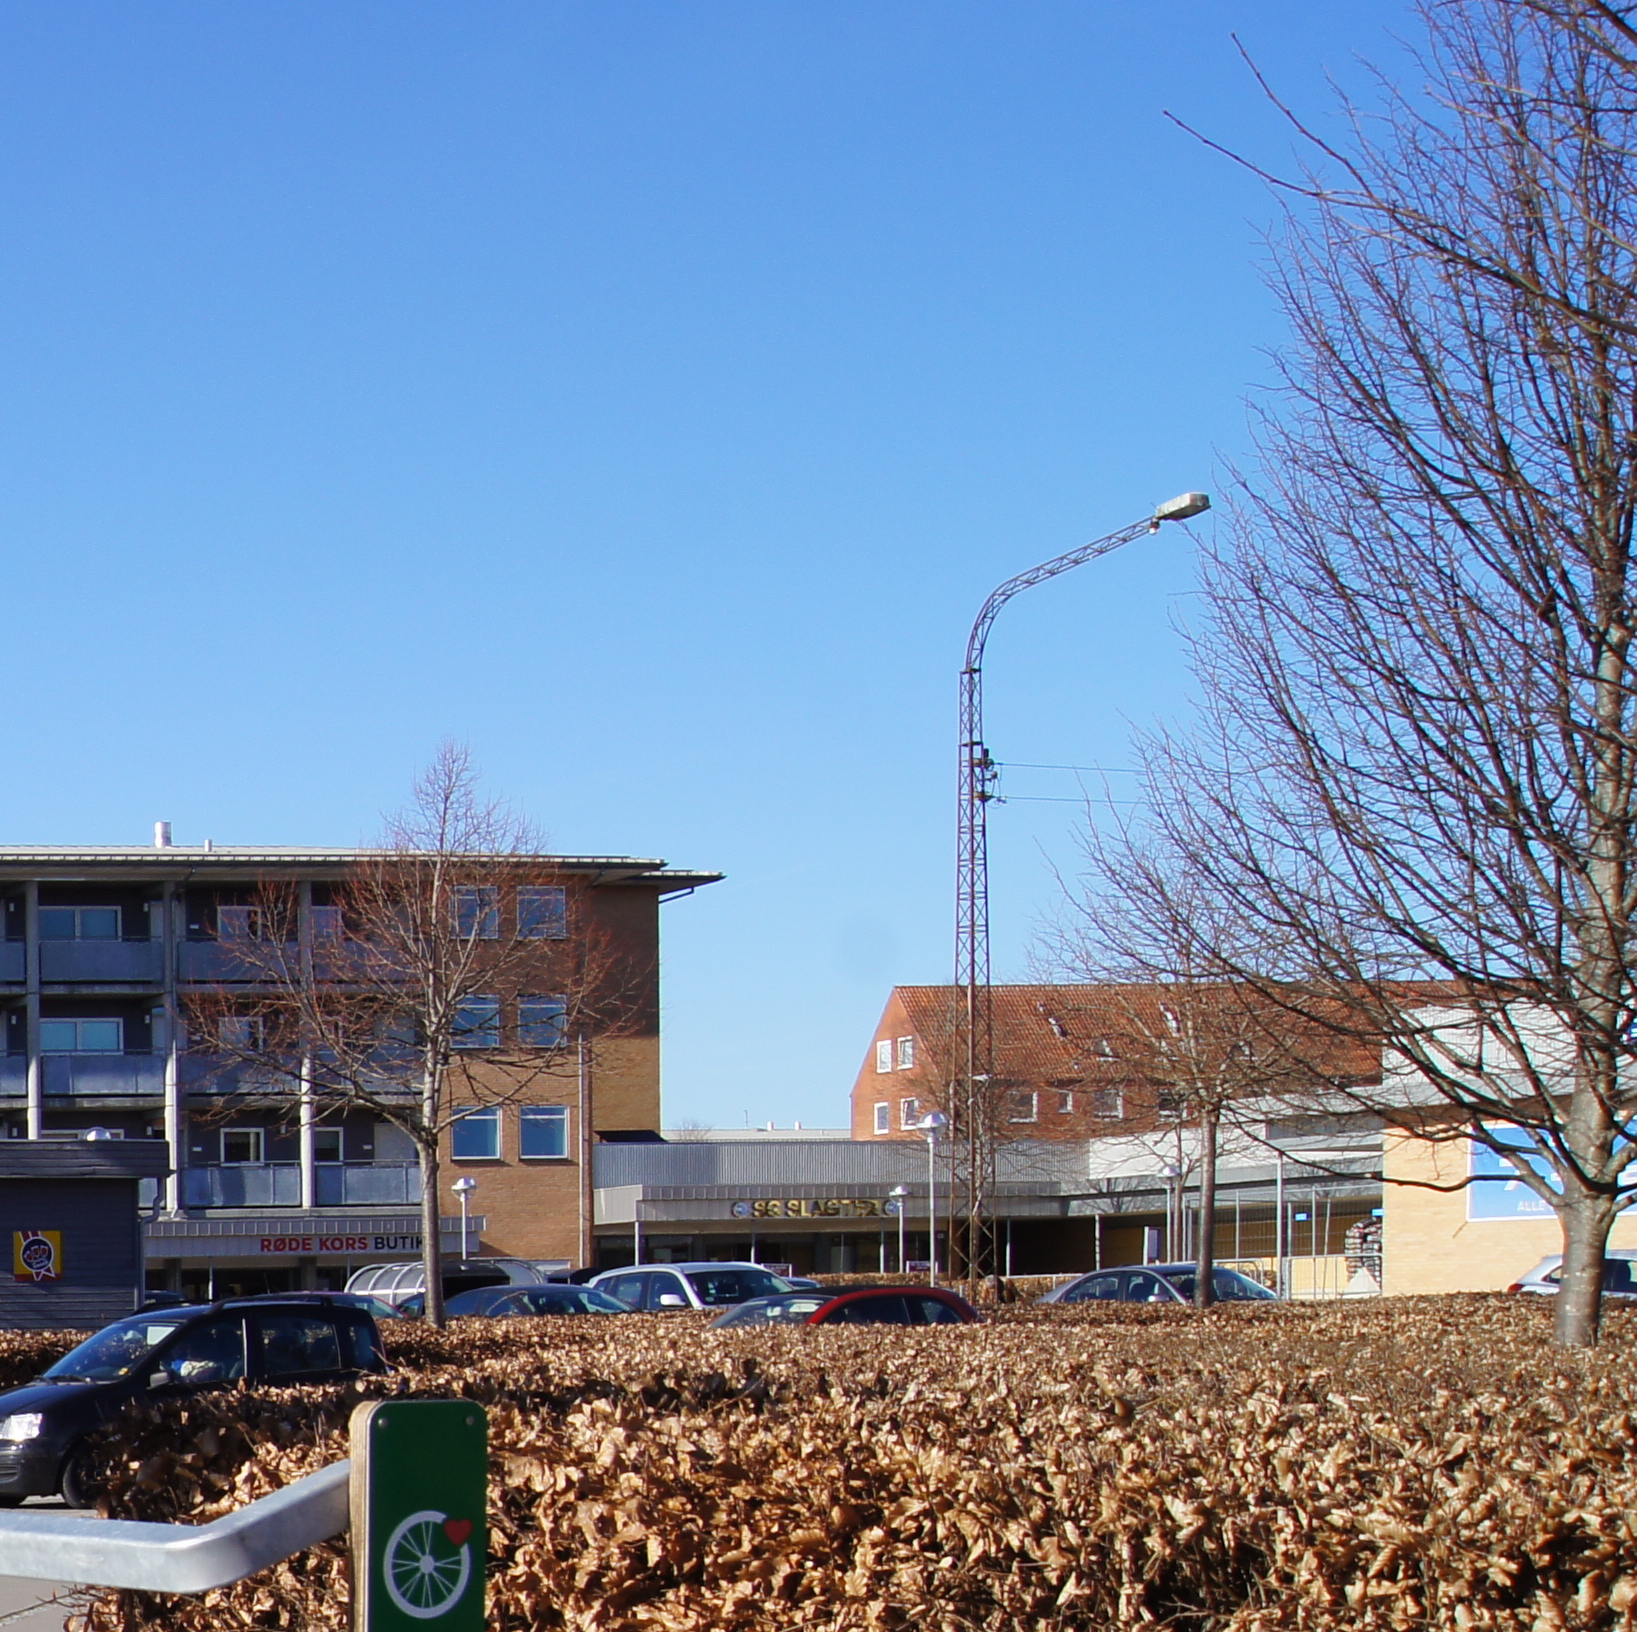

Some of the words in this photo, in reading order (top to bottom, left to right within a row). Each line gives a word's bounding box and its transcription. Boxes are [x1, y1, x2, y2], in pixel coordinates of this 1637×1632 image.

[260, 1237, 313, 1252] RØDE
[319, 1236, 368, 1251] KORS
[375, 1236, 423, 1250] BUTIK
